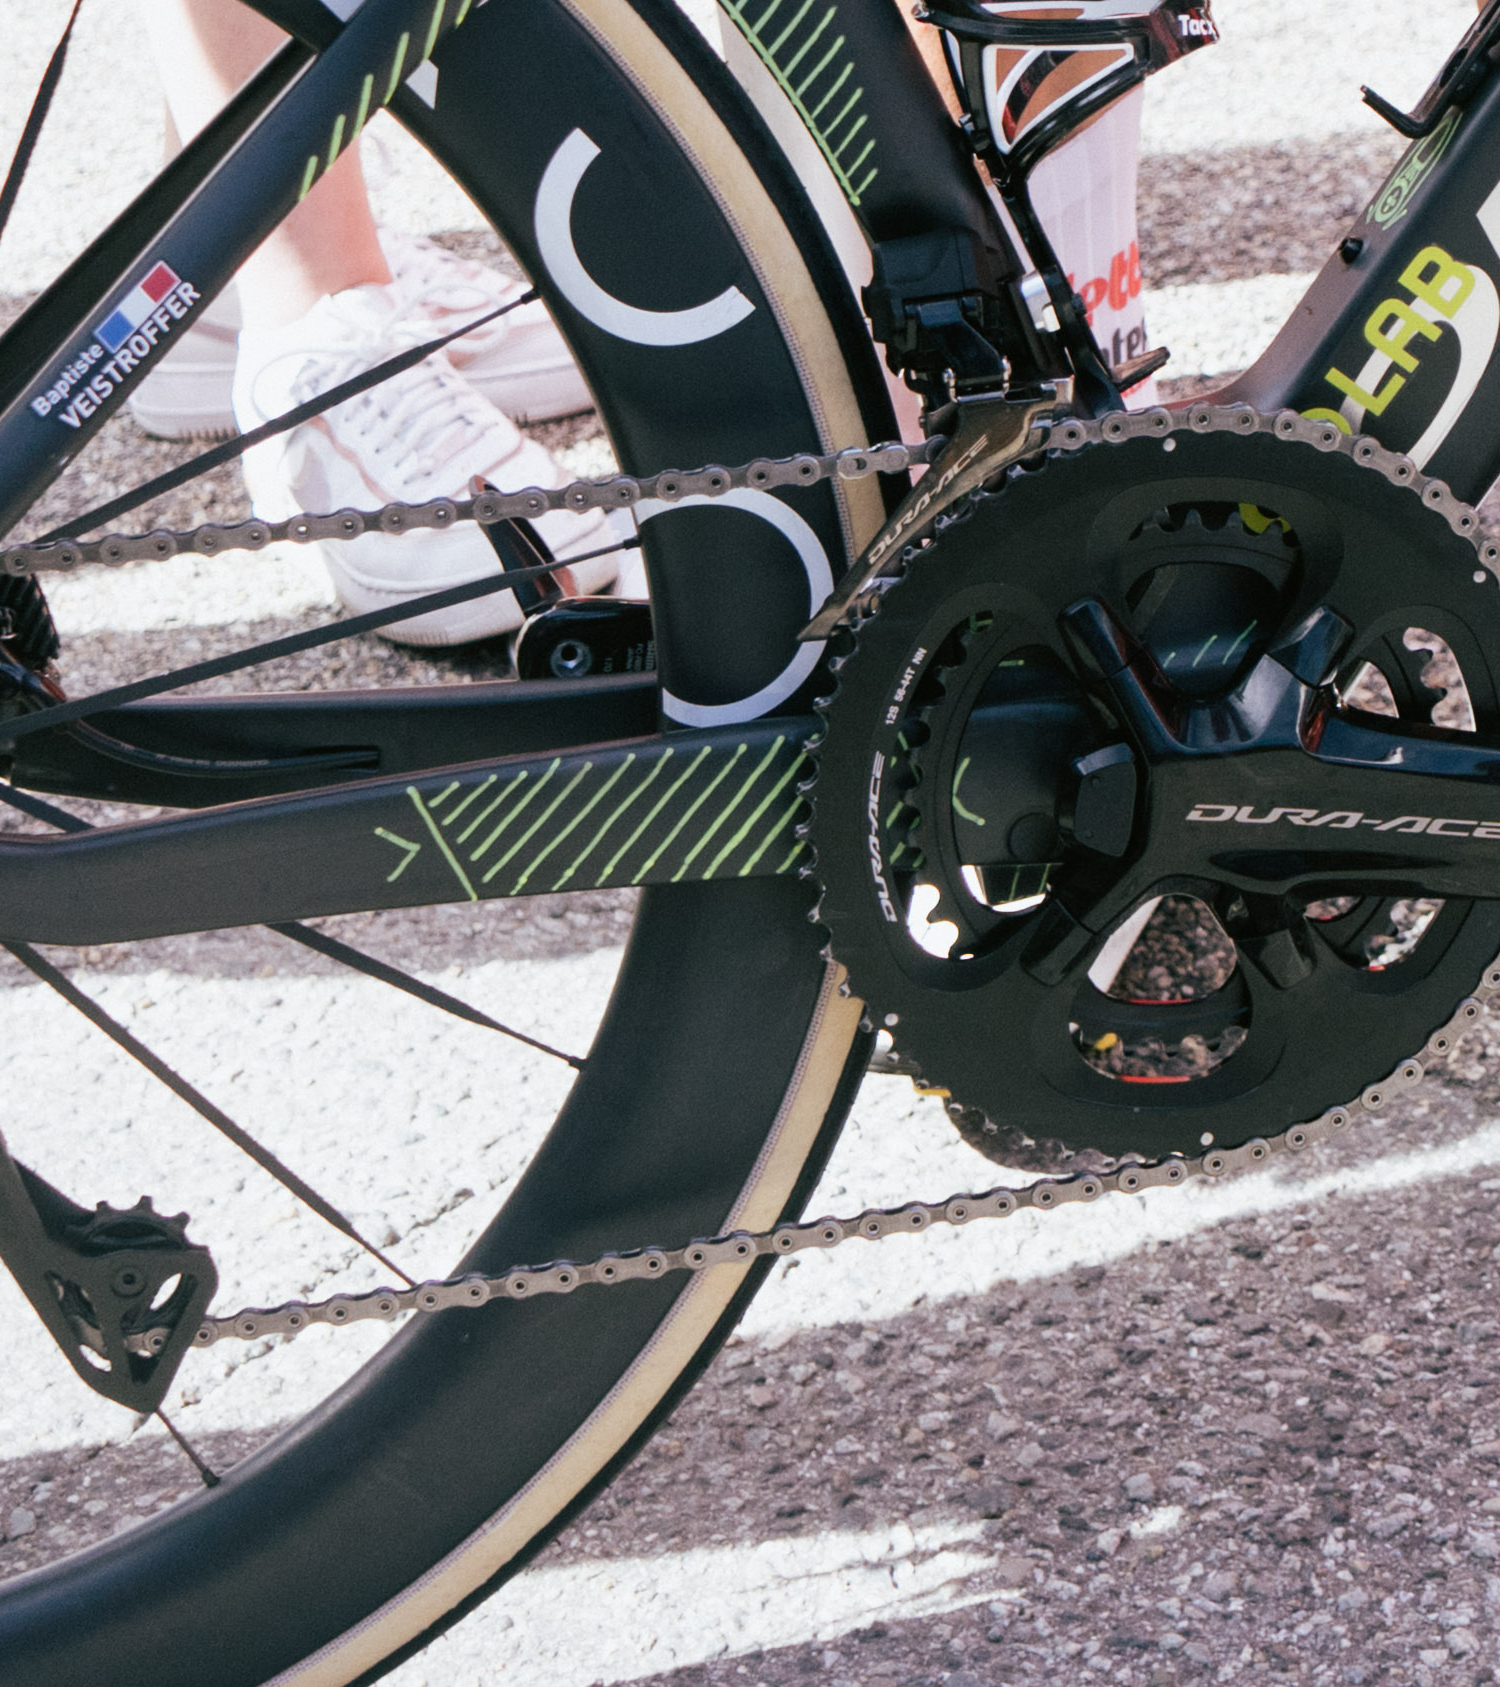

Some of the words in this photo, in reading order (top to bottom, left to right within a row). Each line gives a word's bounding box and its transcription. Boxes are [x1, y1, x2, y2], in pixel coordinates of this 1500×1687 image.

[1178, 12, 1218, 38] Tacx
[30, 343, 105, 417] Baptiste
[58, 281, 202, 429] VEISTROFFER
[868, 433, 990, 566] DURA-ACE
[884, 699, 899, 726] 12S
[912, 646, 928, 667] NN
[867, 750, 898, 924] DURA-ACE
